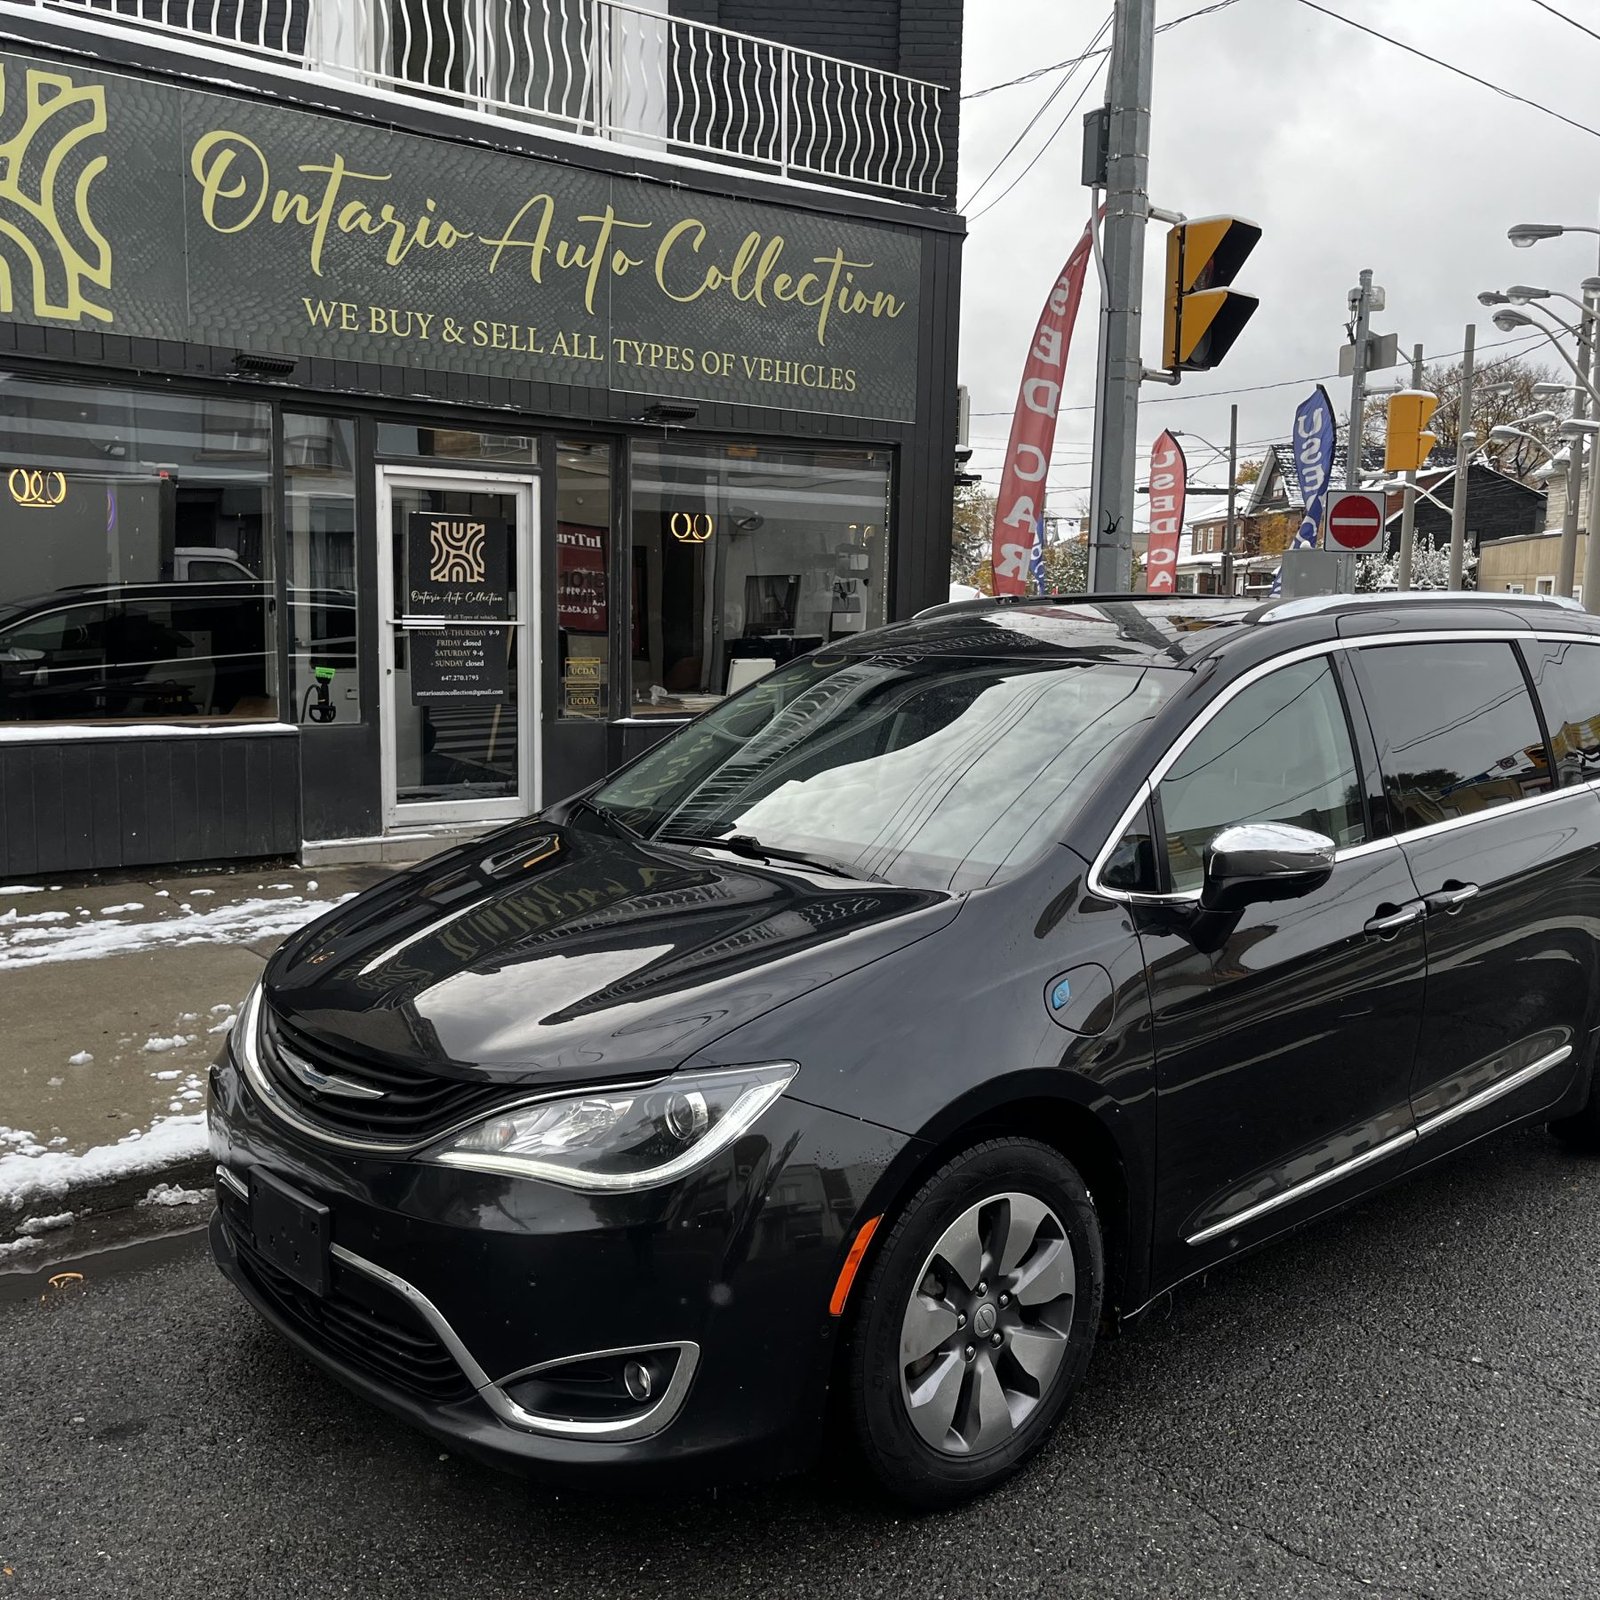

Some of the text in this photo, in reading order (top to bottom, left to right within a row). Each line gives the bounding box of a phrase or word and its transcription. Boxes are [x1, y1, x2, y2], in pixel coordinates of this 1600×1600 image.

[190, 130, 906, 346] Ontario Auto Collection
[301, 297, 857, 392] WE BUY & SELL ALL TYPES OF VEHICLES
[411, 590, 503, 606] Ontario Auto Collection
[436, 639, 482, 647] FRIDAY closed
[434, 649, 471, 657] SATURDAY
[571, 667, 596, 675] UCDA
[571, 697, 596, 705] UCDA
